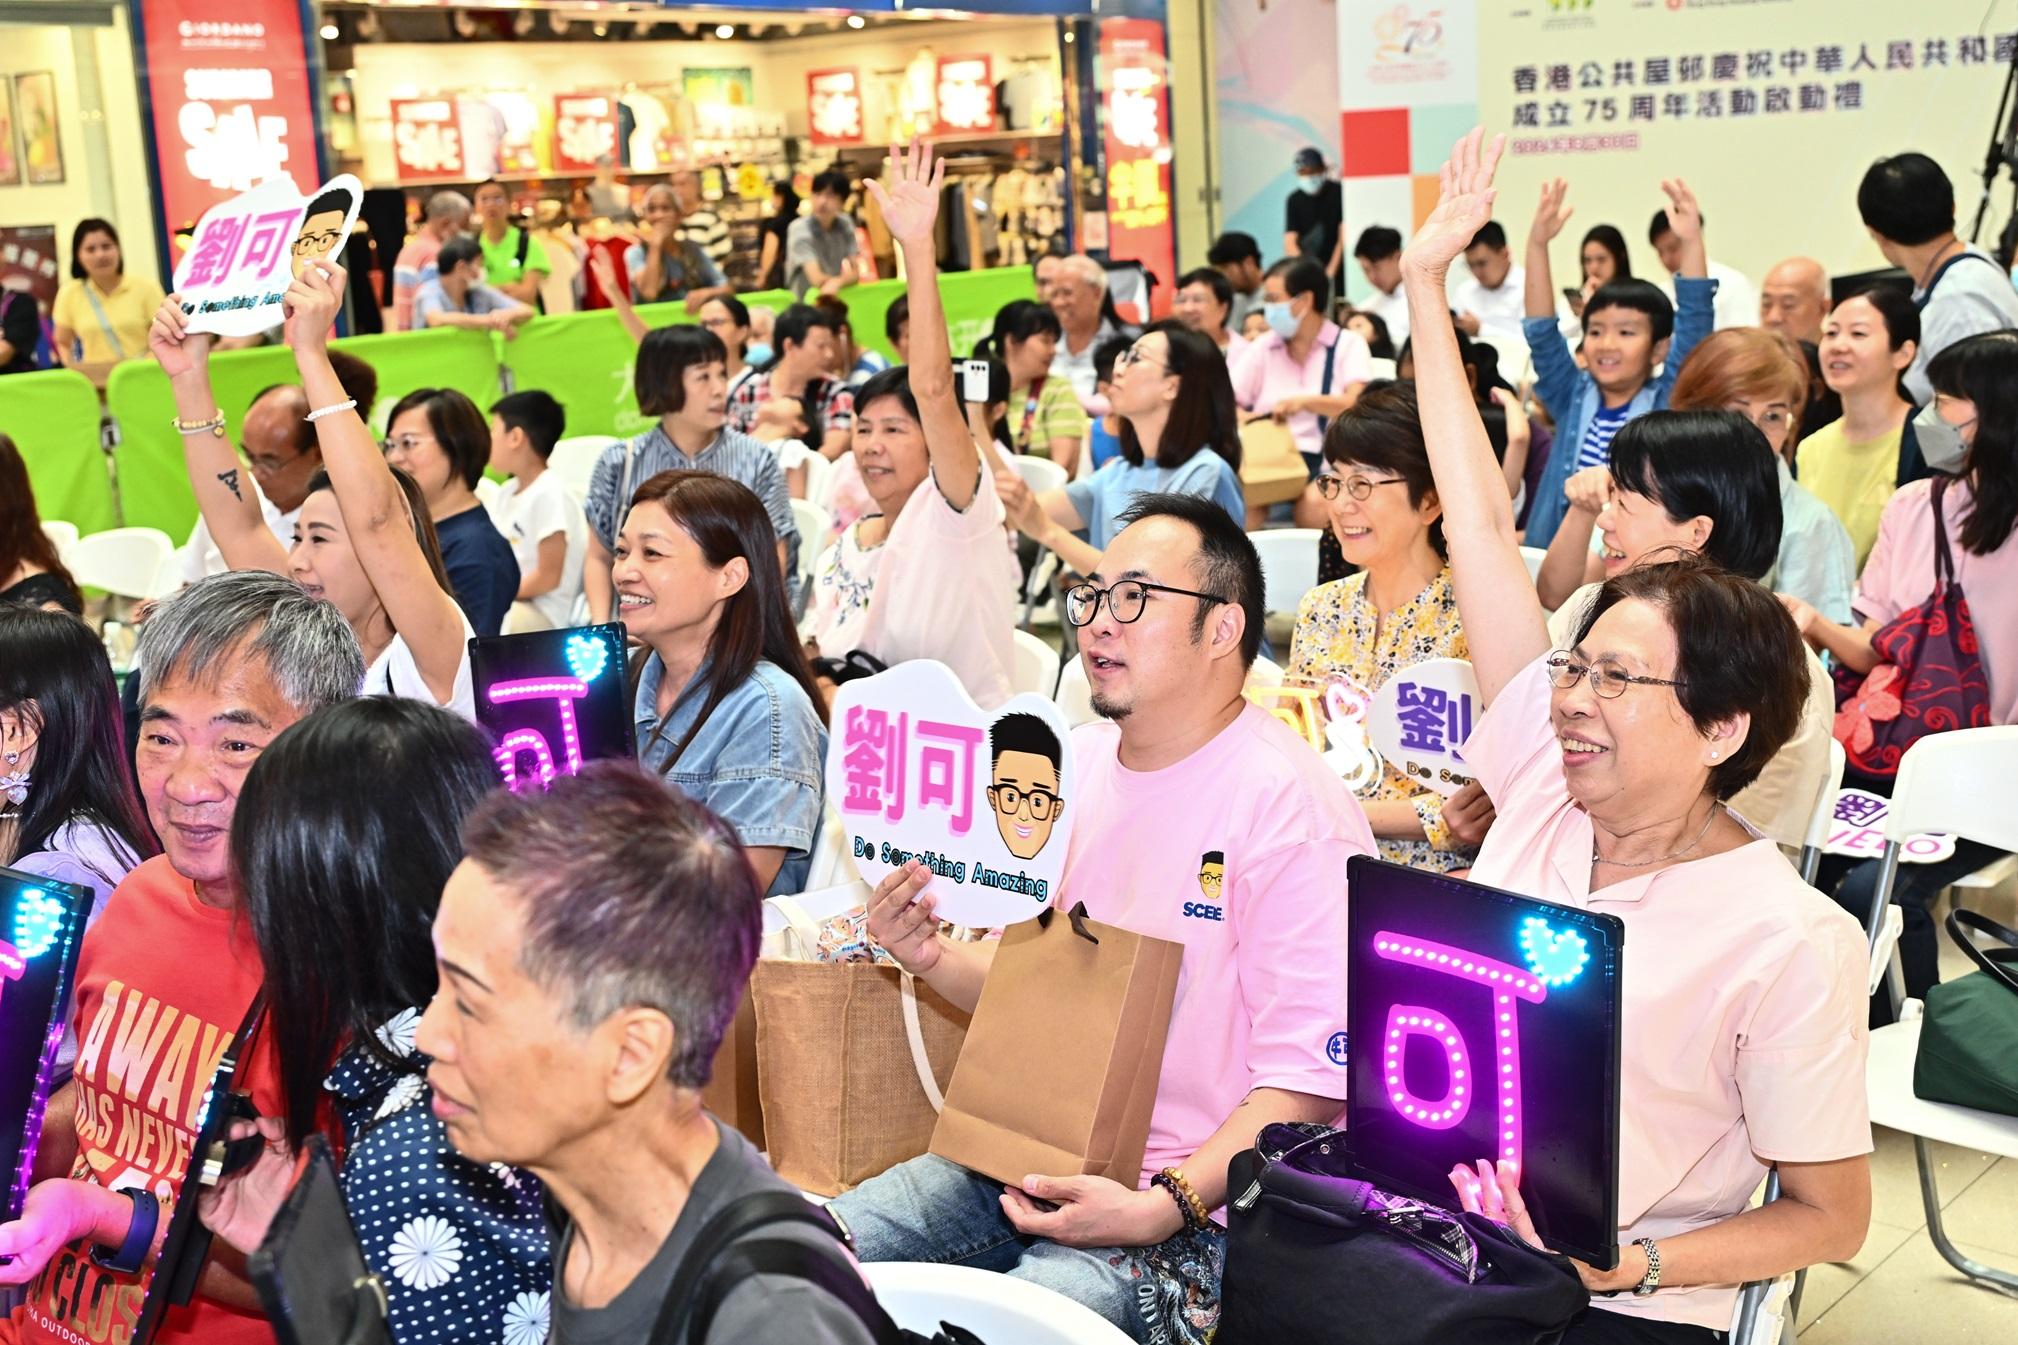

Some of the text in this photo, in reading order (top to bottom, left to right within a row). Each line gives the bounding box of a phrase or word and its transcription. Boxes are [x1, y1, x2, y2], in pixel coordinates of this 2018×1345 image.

[178, 207, 303, 290] 劉可
[1397, 682, 1472, 762] 劉
[841, 704, 985, 838] 劉可
[1406, 761, 1433, 780] Do
[853, 836, 1049, 903] Do Somthing Amazing
[114, 1103, 198, 1180] NEVE
[41, 1316, 93, 1345] OUTDOO
